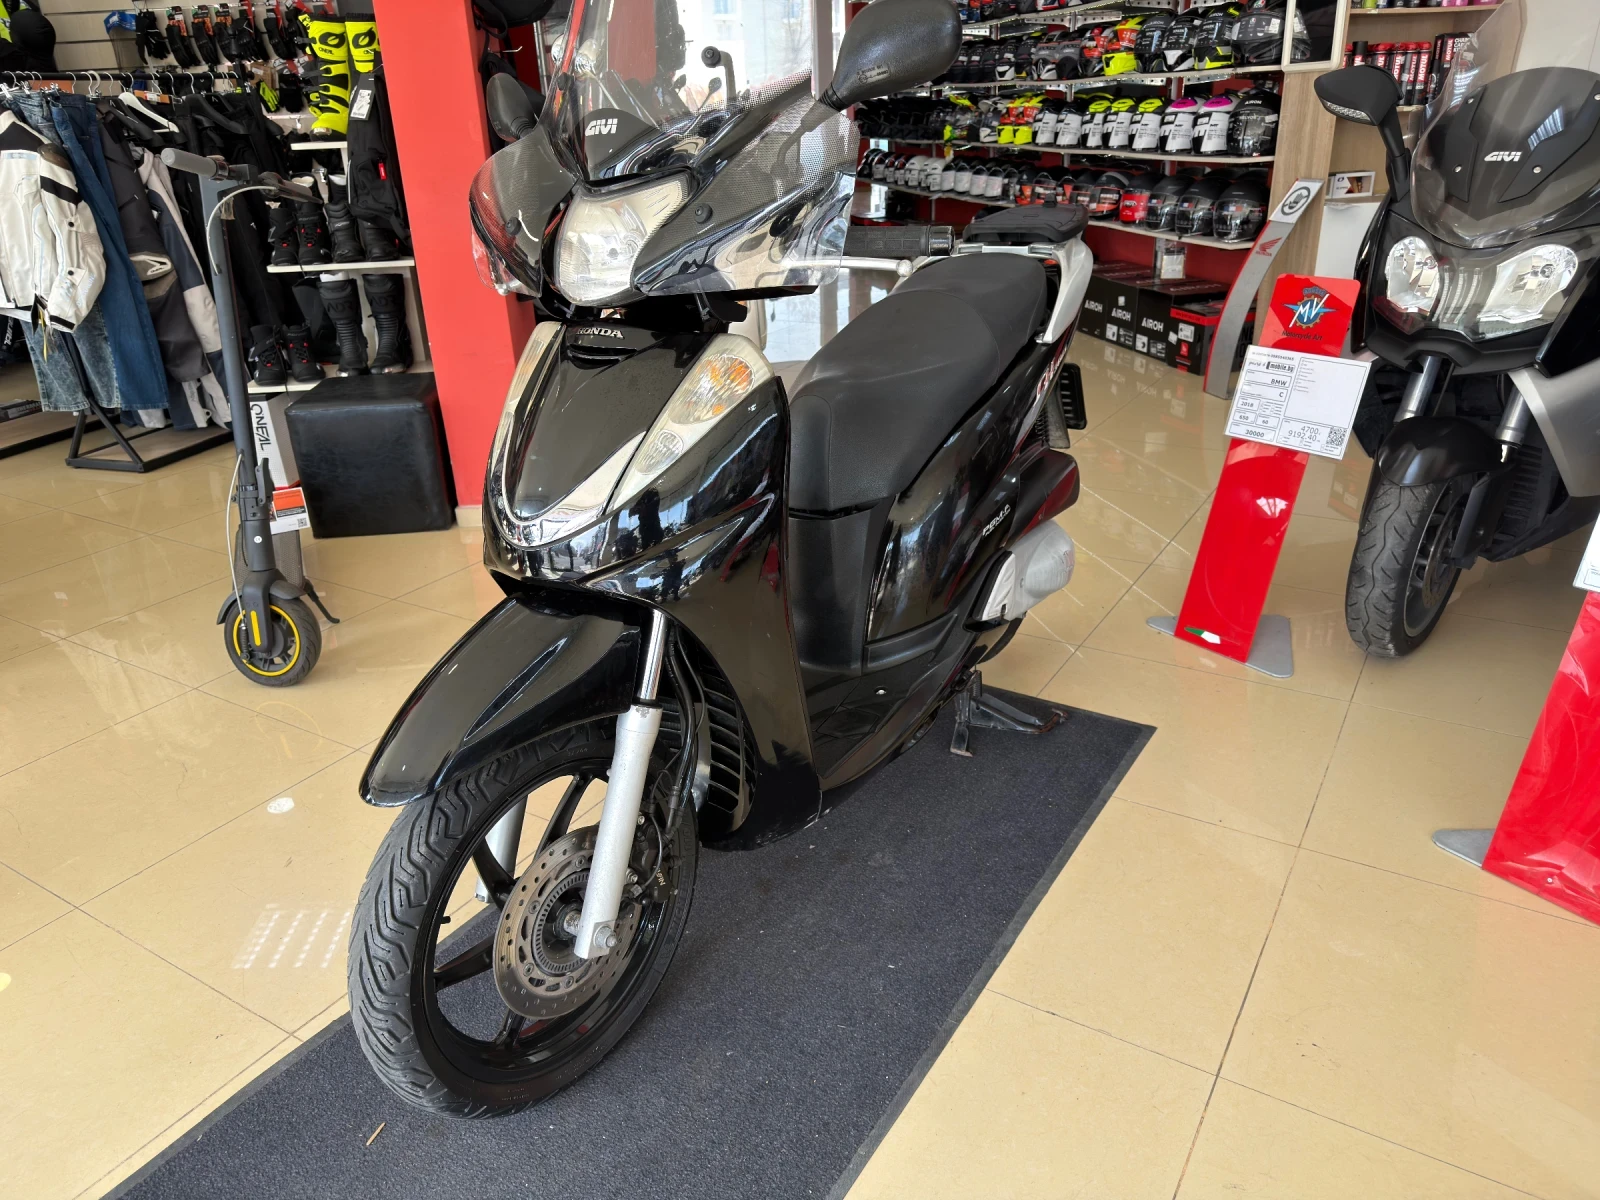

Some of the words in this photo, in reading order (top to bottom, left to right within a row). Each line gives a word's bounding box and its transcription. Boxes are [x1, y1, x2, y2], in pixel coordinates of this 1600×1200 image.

[1446, 38, 1454, 61] MOTUL
[1409, 54, 1418, 81] MOTUL
[1418, 53, 1429, 81] MOTUL
[584, 118, 618, 137] GIVI
[1483, 151, 1522, 162] GIVI
[1084, 299, 1103, 313] AIROH
[1289, 294, 1330, 328] MV
[1111, 307, 1132, 322] AIROH
[1141, 317, 1164, 333] AIROH
[576, 327, 625, 340] HONDA
[1281, 330, 1311, 340] Motorcycle
[1270, 363, 1294, 373] mobile.bg
[1270, 378, 1288, 387] BMW
[1245, 429, 1265, 438] 30000
